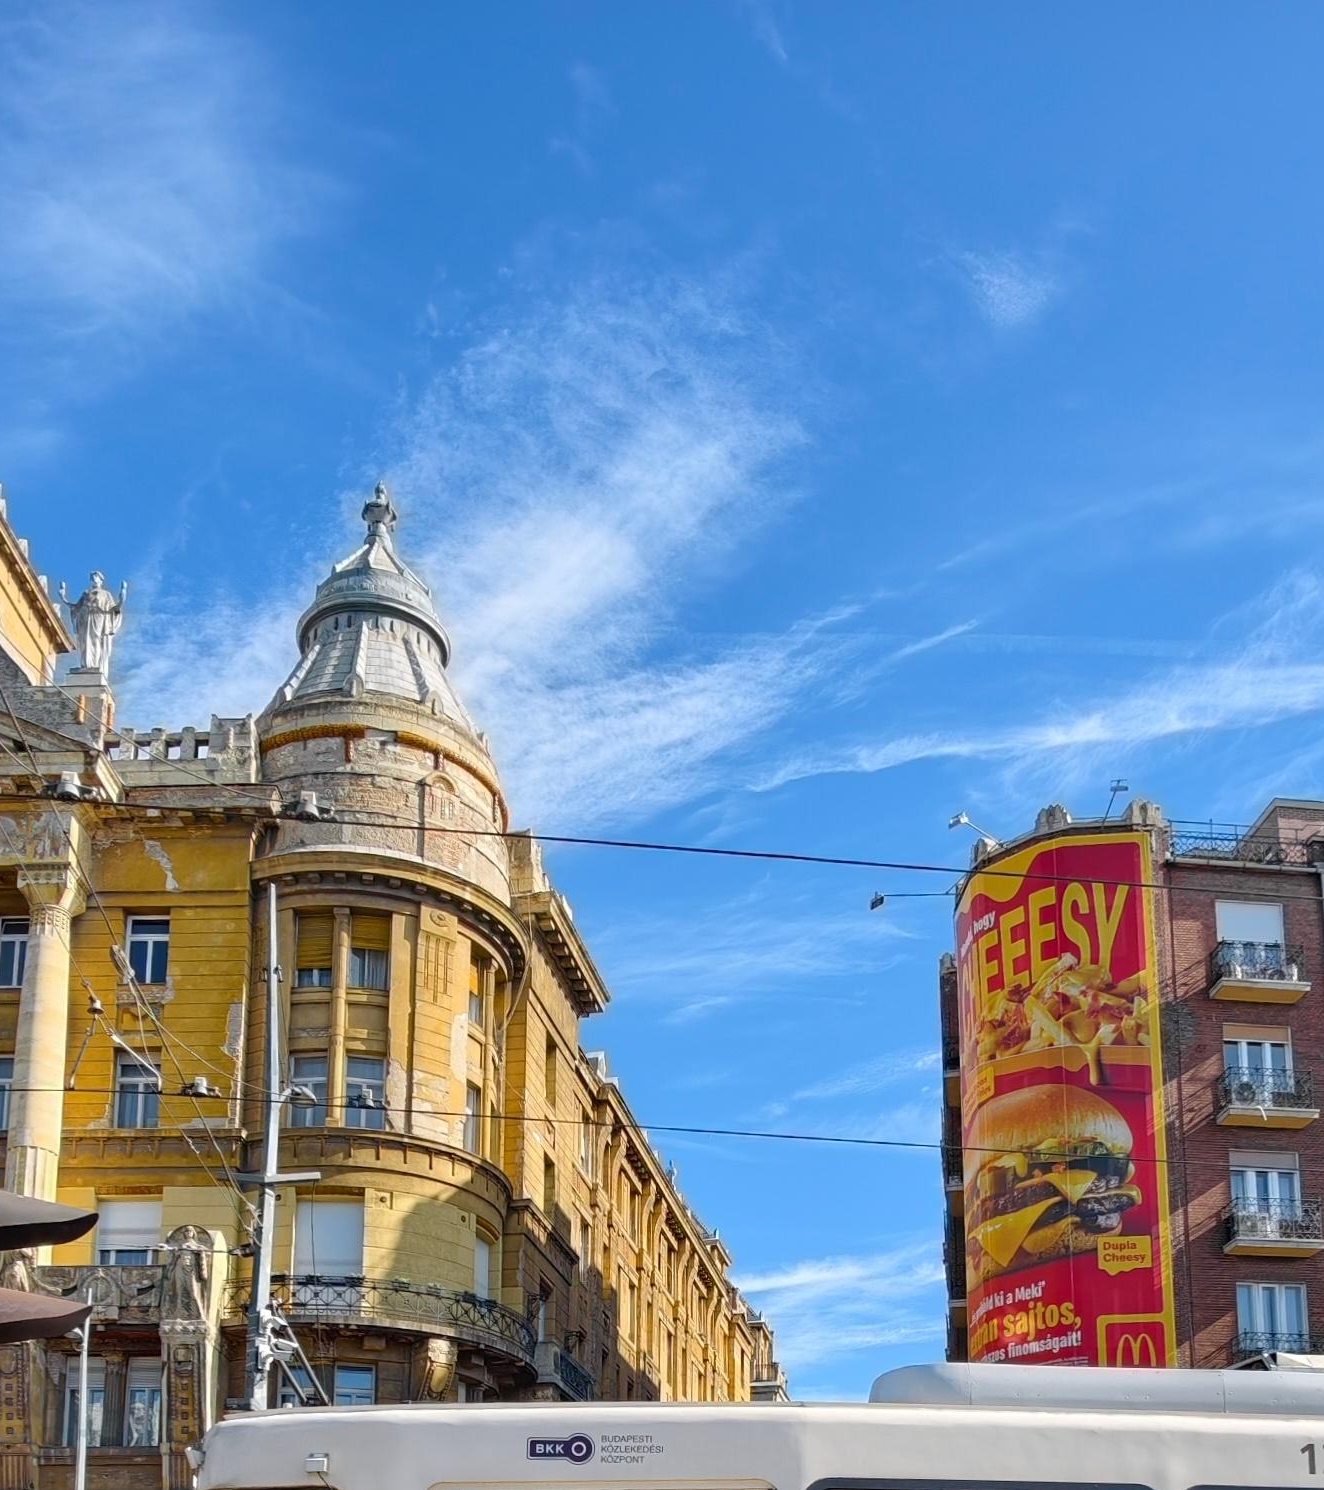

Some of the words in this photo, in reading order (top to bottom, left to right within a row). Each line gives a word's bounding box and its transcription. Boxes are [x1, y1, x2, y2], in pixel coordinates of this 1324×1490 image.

[972, 910, 996, 936] hogy
[1103, 1240, 1137, 1253] Dupla
[1103, 1252, 1147, 1264] Cheesy
[1005, 1291, 1014, 1304] a
[1002, 1301, 1081, 1342] sajtos,
[1007, 1331, 1082, 1359] finomságait!
[601, 1434, 653, 1443] BUDAPESTI
[536, 1443, 565, 1454] BKK
[600, 1443, 664, 1454] KÖZLEKEDÉSI
[600, 1454, 645, 1464] KÖZPONT
